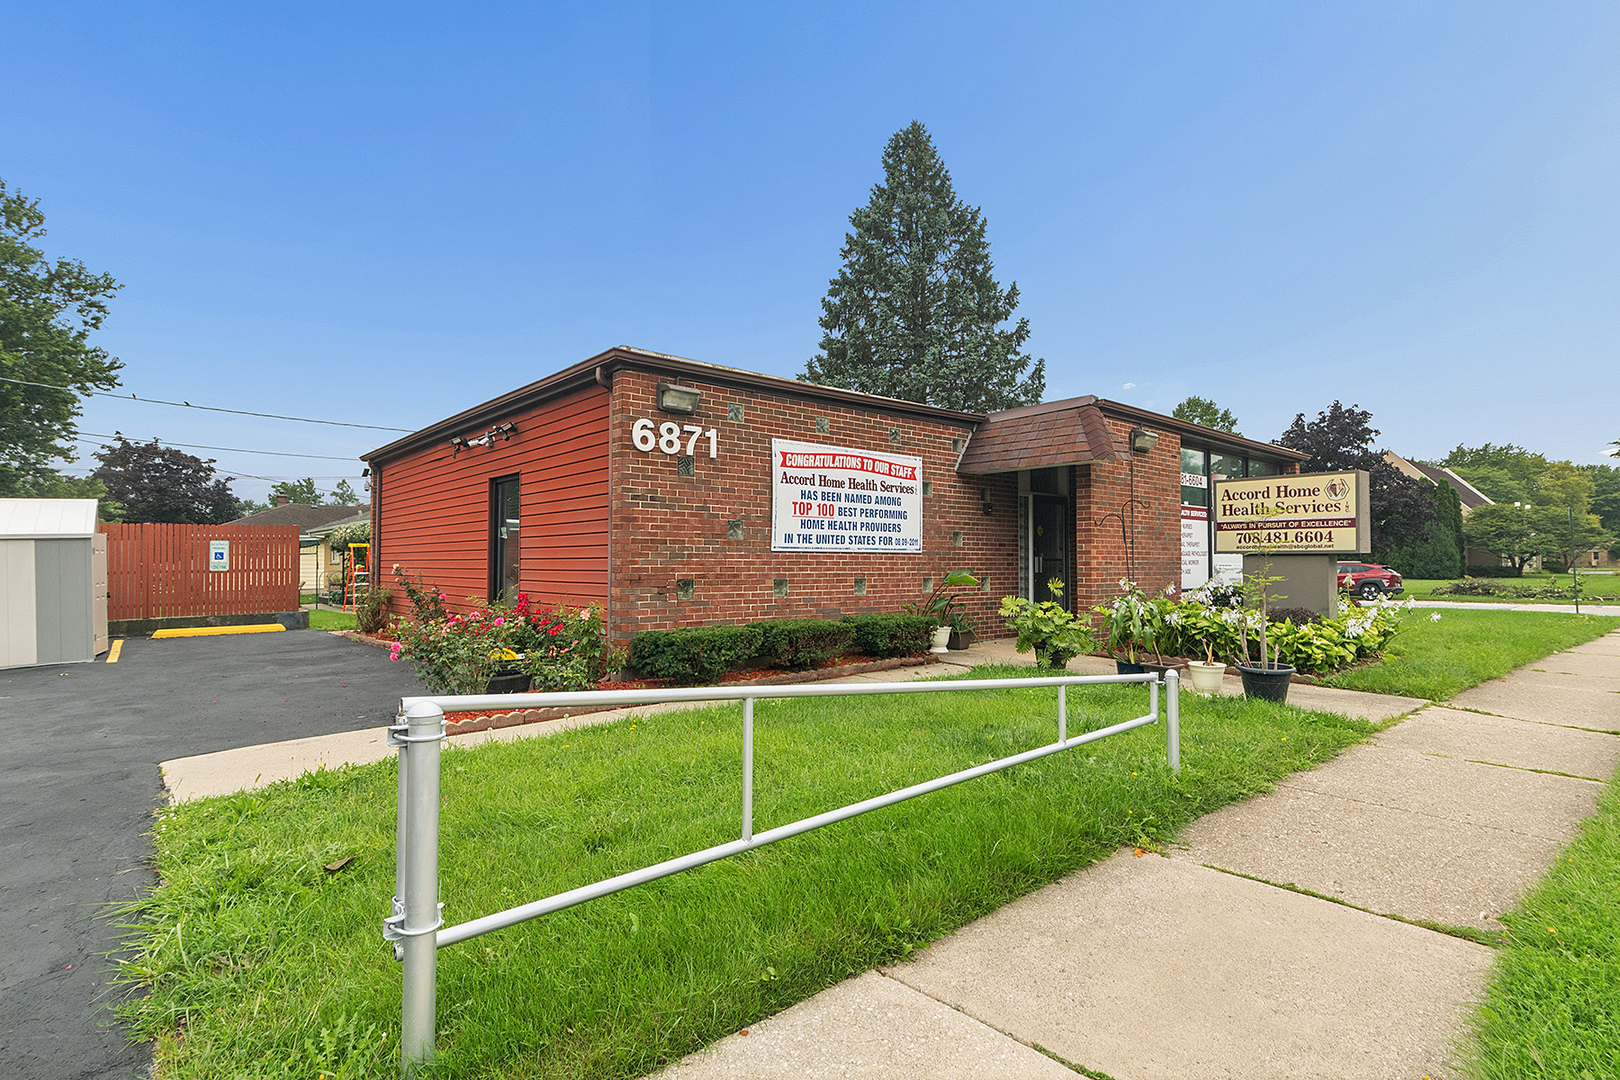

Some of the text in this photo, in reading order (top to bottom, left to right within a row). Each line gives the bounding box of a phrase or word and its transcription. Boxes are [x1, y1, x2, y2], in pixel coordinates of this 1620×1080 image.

[632, 418, 717, 458] 6871
[786, 454, 912, 478] CONGRATULATIONS TO OUR STAFF
[780, 471, 815, 486] Accord
[818, 475, 845, 488] Home
[848, 478, 877, 491] Health
[880, 481, 914, 494] Services
[801, 490, 901, 506] HAS BEEN NAMED AMONG
[1221, 485, 1320, 501] Accord Home
[792, 502, 908, 520] TOP 100 BEST PERFORMING
[1222, 500, 1341, 516] Health Services
[801, 519, 901, 532] HOME HEALTH PROVIDERS
[784, 534, 793, 544] IN
[797, 534, 813, 544] THE
[816, 535, 845, 544] UNITED
[848, 535, 876, 545] STATES
[879, 536, 893, 545] FOR
[1236, 530, 1334, 544] 708.481.6604
